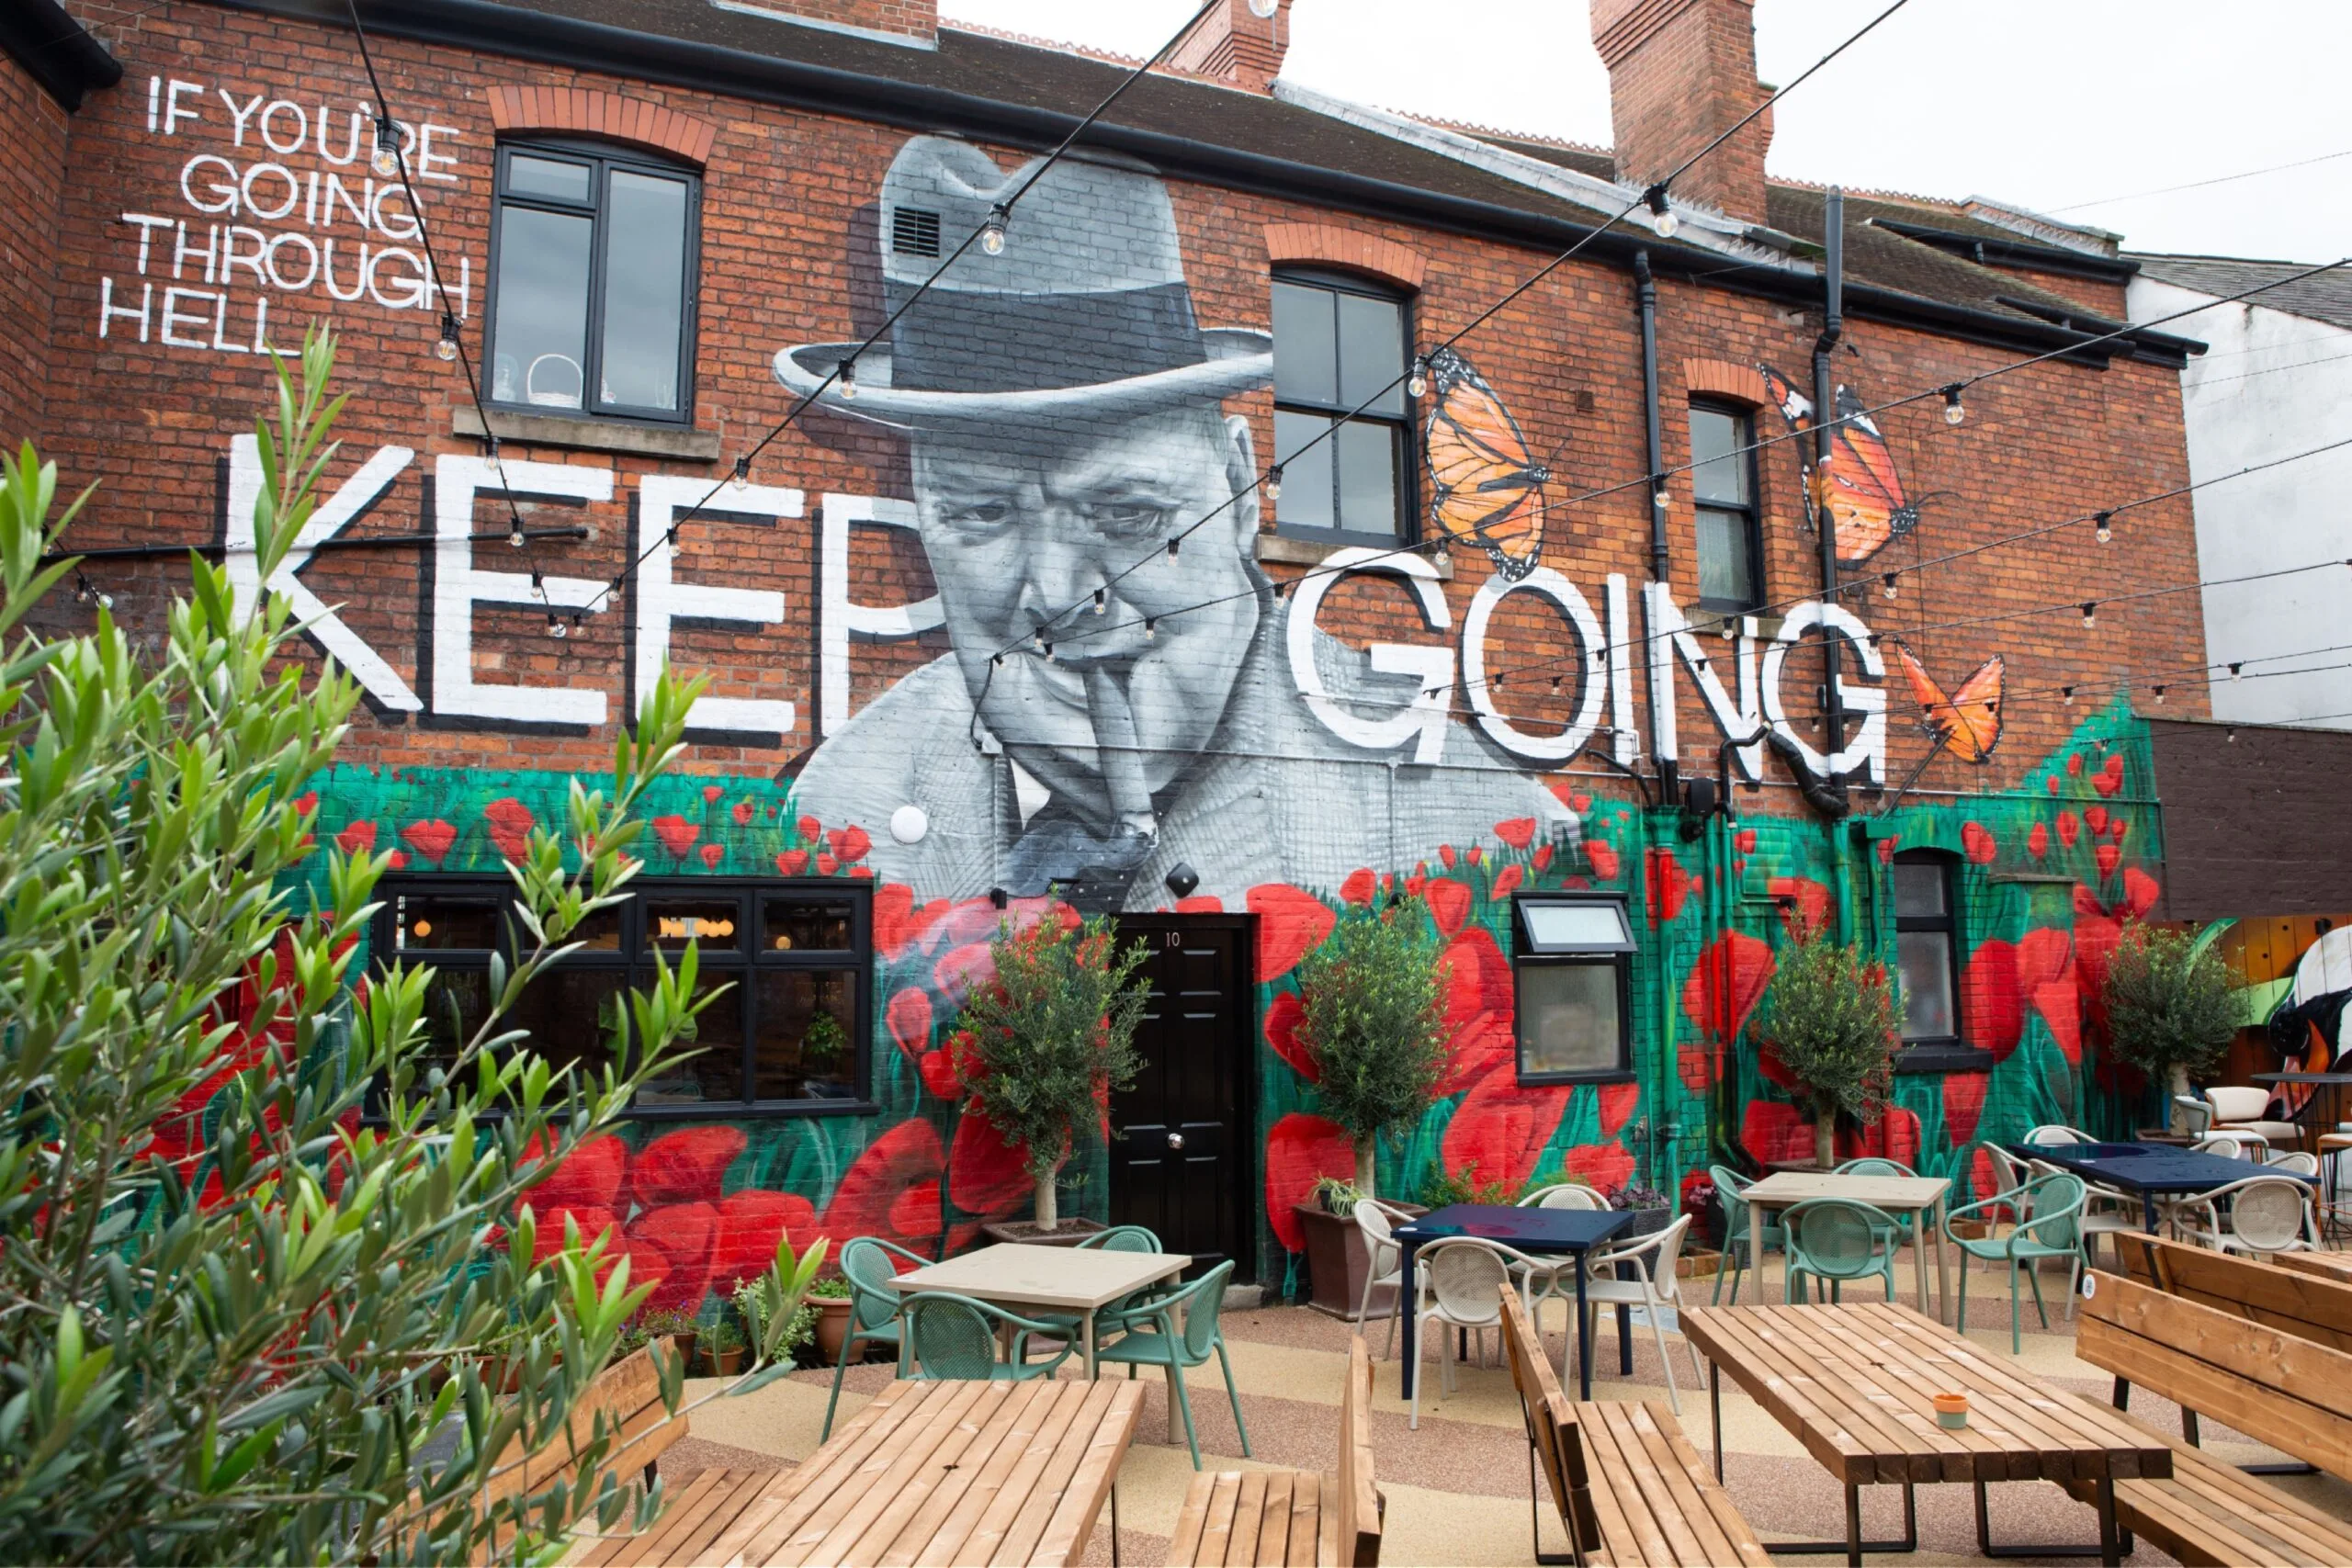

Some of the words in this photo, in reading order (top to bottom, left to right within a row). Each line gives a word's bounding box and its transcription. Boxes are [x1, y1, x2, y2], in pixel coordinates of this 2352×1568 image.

[148, 75, 204, 135] IF
[219, 88, 459, 182] YOU'RE
[181, 153, 425, 243] GOING
[121, 213, 470, 325] THROUGH
[222, 434, 950, 739] KEEP
[1286, 547, 1888, 784] GOING
[1165, 931, 1181, 947] 10
